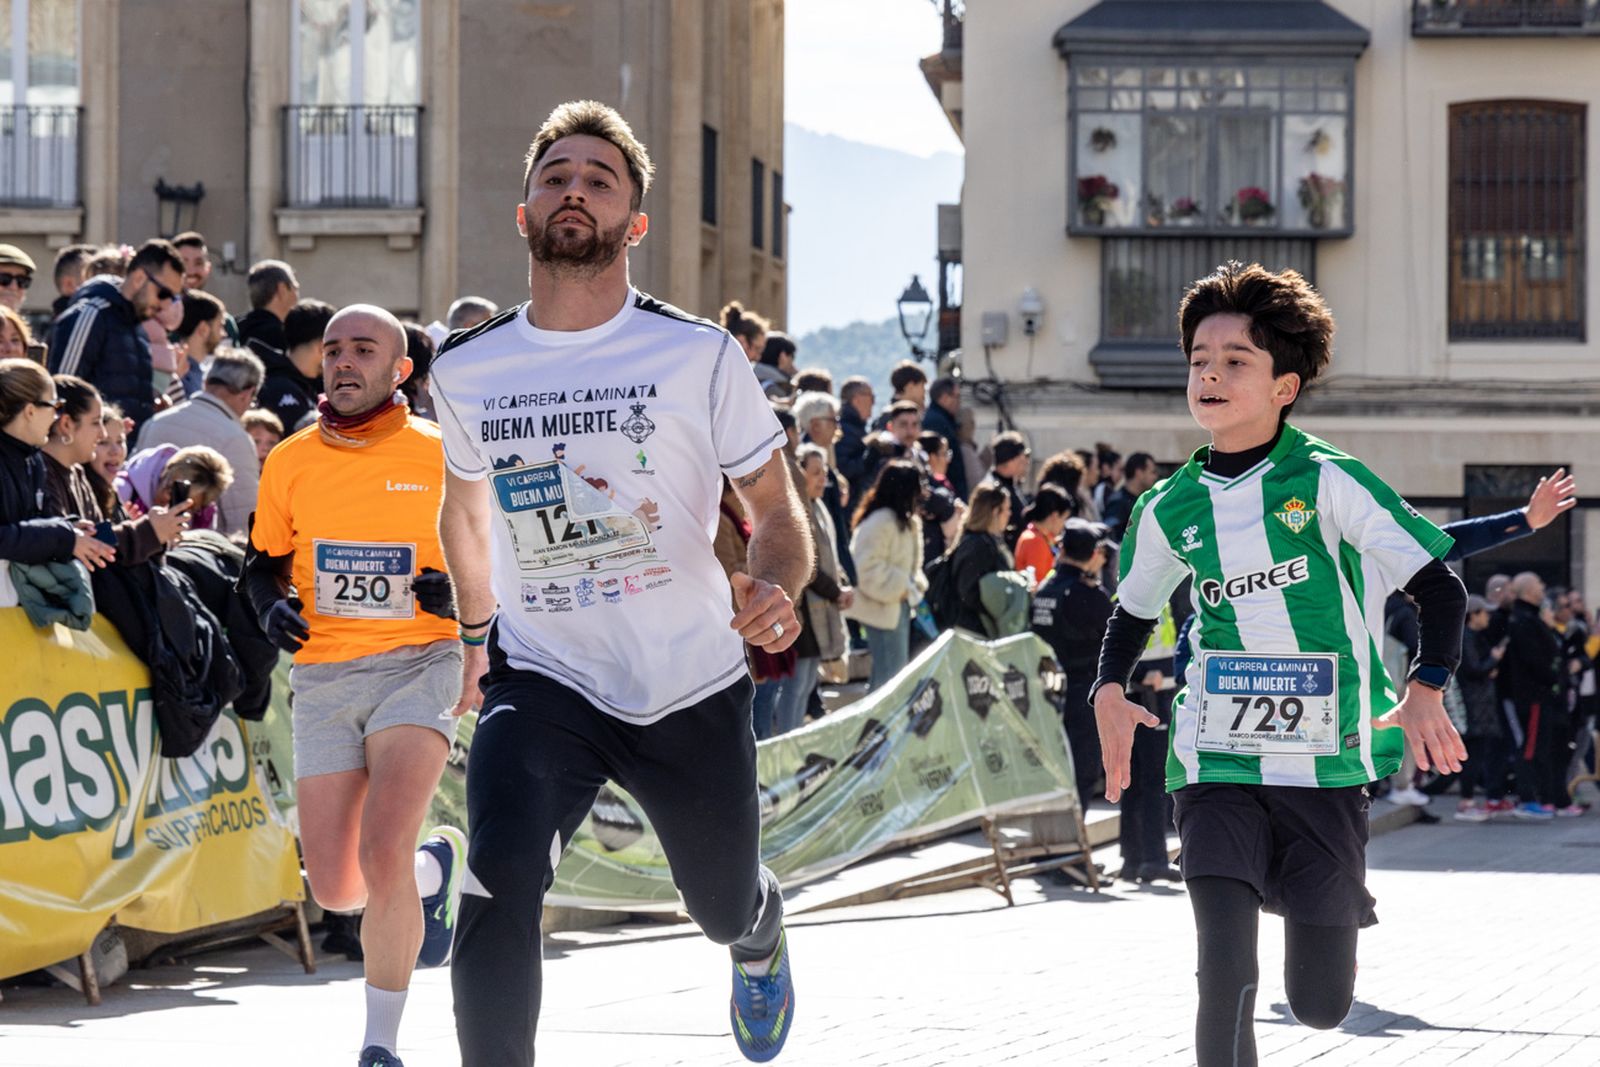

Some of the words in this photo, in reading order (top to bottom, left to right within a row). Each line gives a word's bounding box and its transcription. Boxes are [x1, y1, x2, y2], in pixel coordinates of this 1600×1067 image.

[483, 398, 495, 411] VI
[498, 391, 567, 410] CARRERA
[573, 384, 657, 403] CAMINATA
[481, 416, 535, 442] BUENA
[541, 409, 618, 438] MUERTE
[506, 477, 516, 487] VI
[517, 470, 556, 485] CARRERA
[510, 488, 543, 507] BUENA
[332, 549, 363, 557] CARRERA
[365, 550, 401, 558] CAMINATA
[325, 558, 350, 571] BUENA
[351, 559, 385, 572] MUERTE
[1225, 557, 1307, 598] GREE
[334, 574, 391, 603] 250
[1218, 661, 1228, 670] VI
[1228, 661, 1268, 672] CARRERA
[1270, 662, 1319, 673] CAMINATA
[1218, 675, 1250, 690] BUENA
[1252, 676, 1297, 692] MUERTE
[1230, 696, 1304, 733] 729
